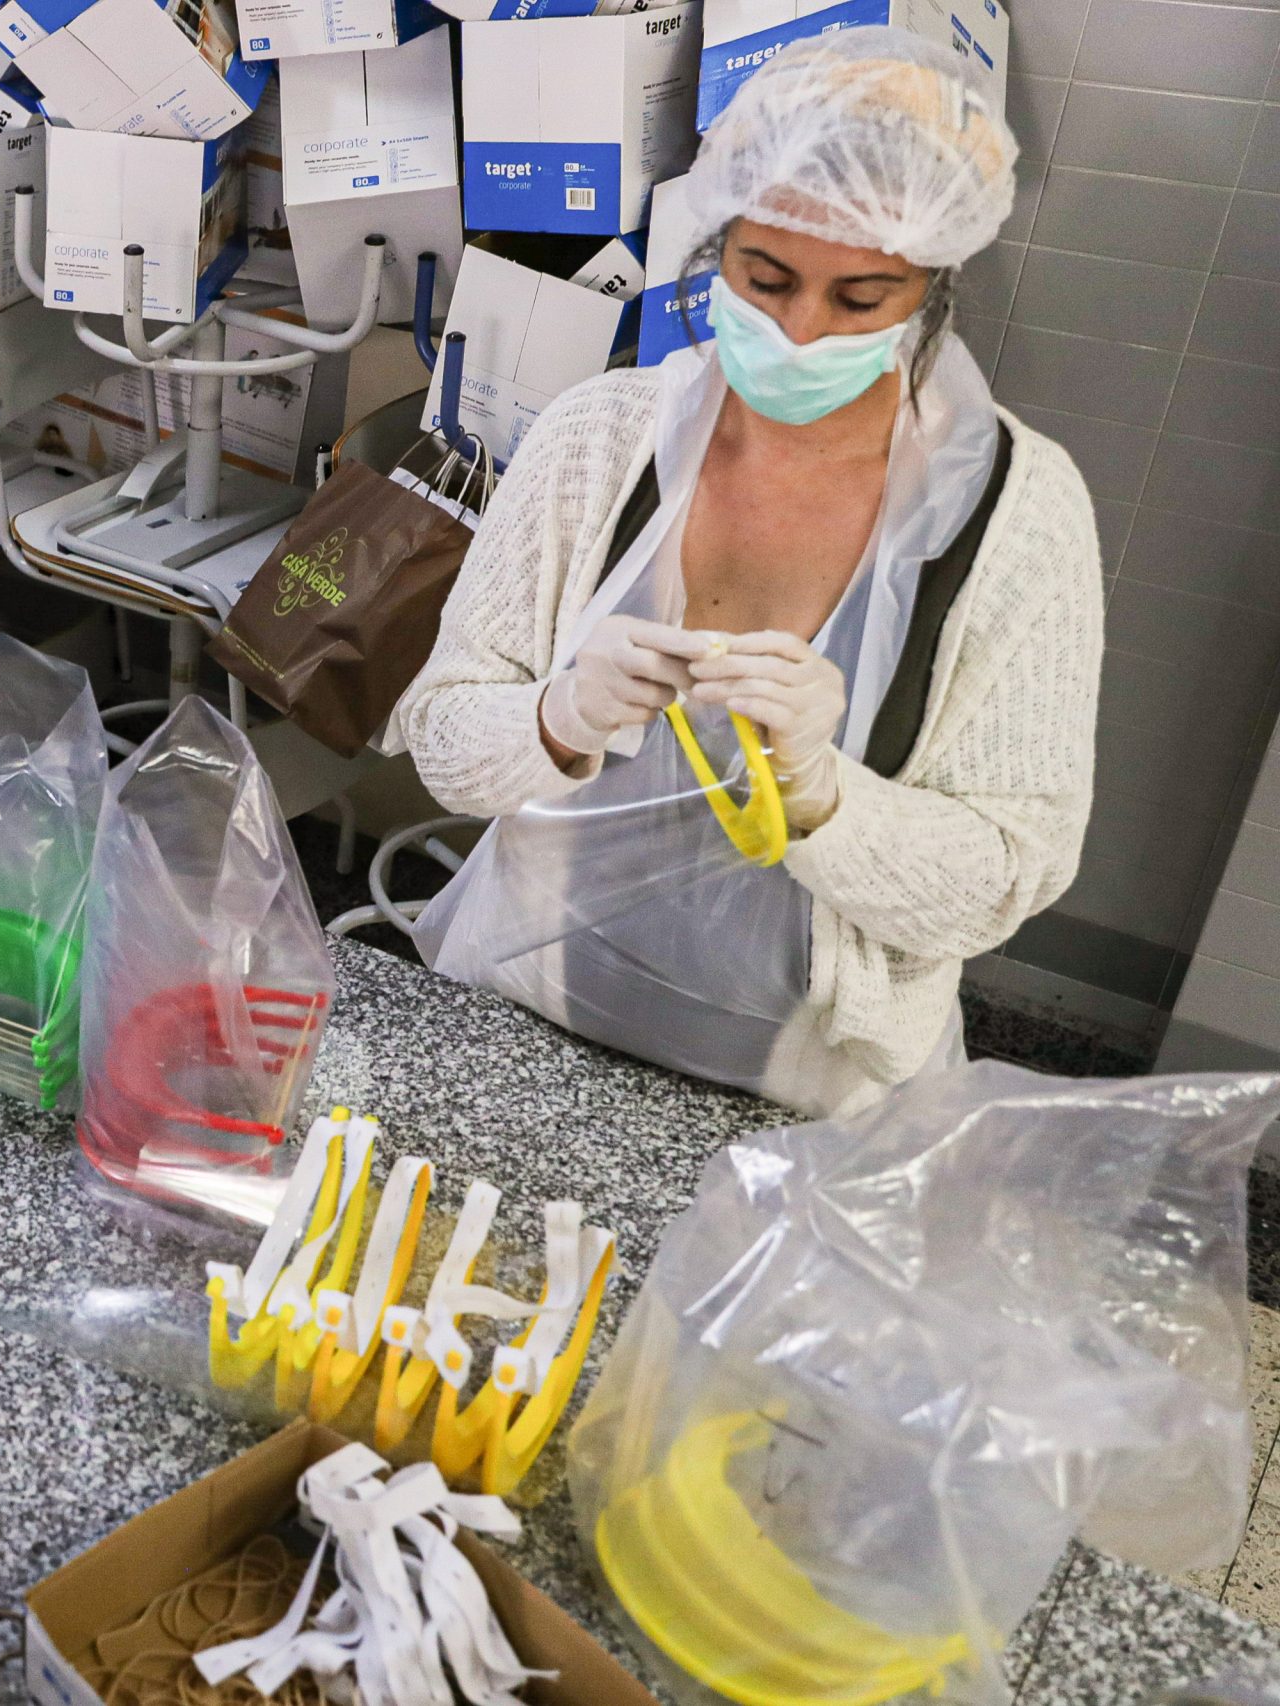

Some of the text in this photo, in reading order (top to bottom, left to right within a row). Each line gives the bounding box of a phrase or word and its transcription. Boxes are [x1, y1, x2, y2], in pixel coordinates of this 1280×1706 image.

[646, 14, 682, 35] target
[252, 41, 264, 50] 80
[726, 42, 783, 71] target
[7, 134, 32, 151] target
[303, 136, 368, 154] corporate
[484, 161, 532, 179] target
[355, 178, 369, 187] 80
[498, 181, 532, 190] corporate
[54, 244, 109, 261] corporate
[55, 291, 68, 300] 80
[461, 376, 498, 400] porate
[281, 553, 347, 608] CASA VERDE
